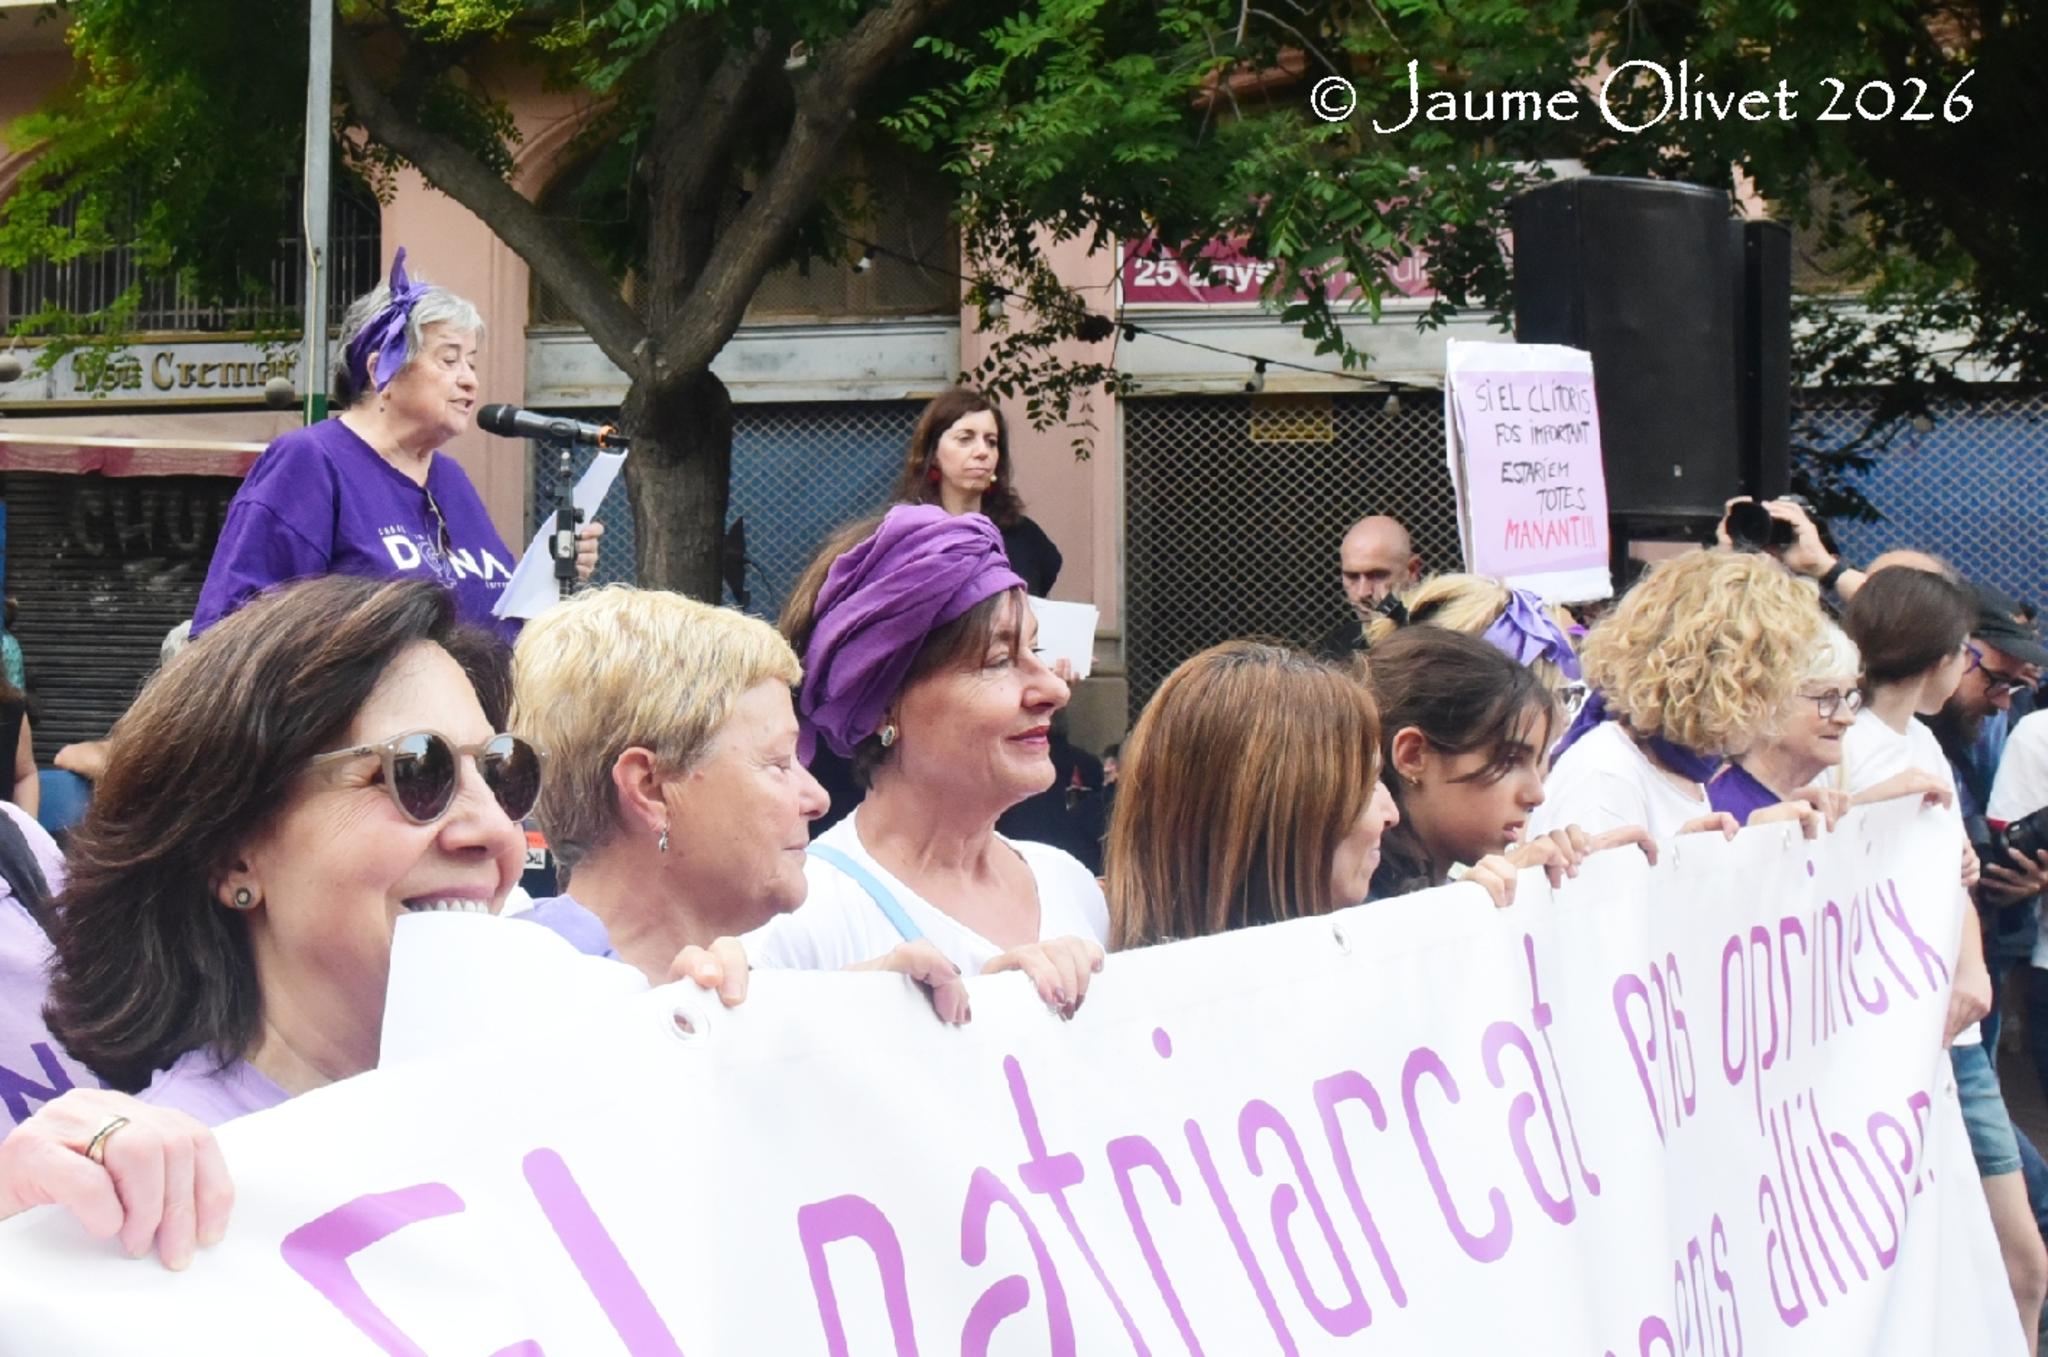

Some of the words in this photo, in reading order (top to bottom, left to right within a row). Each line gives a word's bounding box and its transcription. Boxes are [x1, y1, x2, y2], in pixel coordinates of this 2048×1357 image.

[1134, 259, 1179, 287] 25
[1498, 383, 1521, 412] EL
[1495, 422, 1522, 446] FOS
[1536, 486, 1586, 515] TOTES
[1504, 516, 1597, 551] MANANT!!!
[1759, 1087, 1935, 1328] alliber
